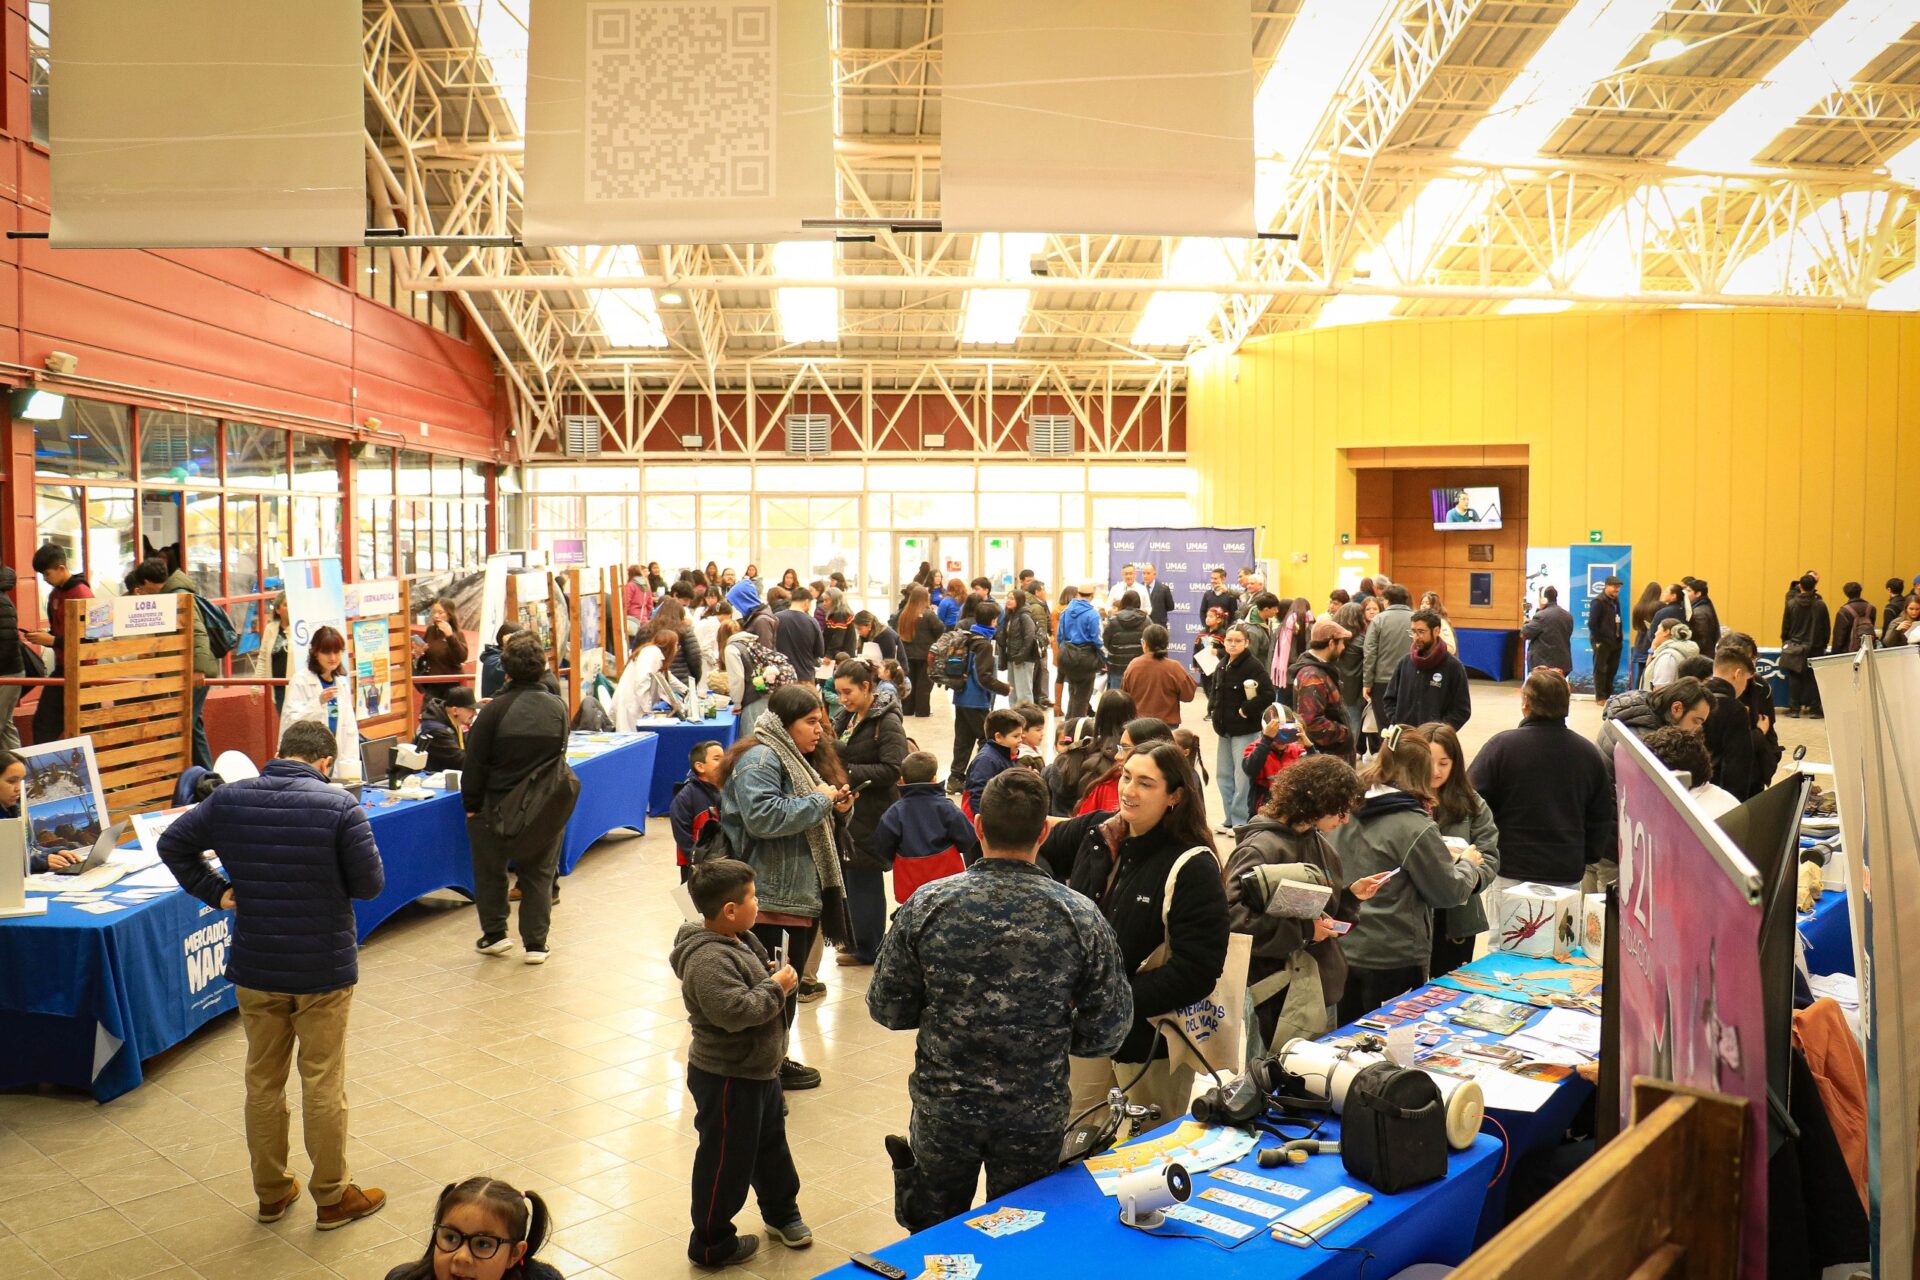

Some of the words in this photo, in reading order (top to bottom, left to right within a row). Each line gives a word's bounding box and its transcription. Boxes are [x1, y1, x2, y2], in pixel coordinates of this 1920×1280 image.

[135, 601, 157, 610] LOBA
[184, 917, 229, 956] MERCADOS
[186, 946, 228, 995] MAR
[1186, 1018, 1199, 1032] DEL
[1199, 1016, 1218, 1032] MAR
